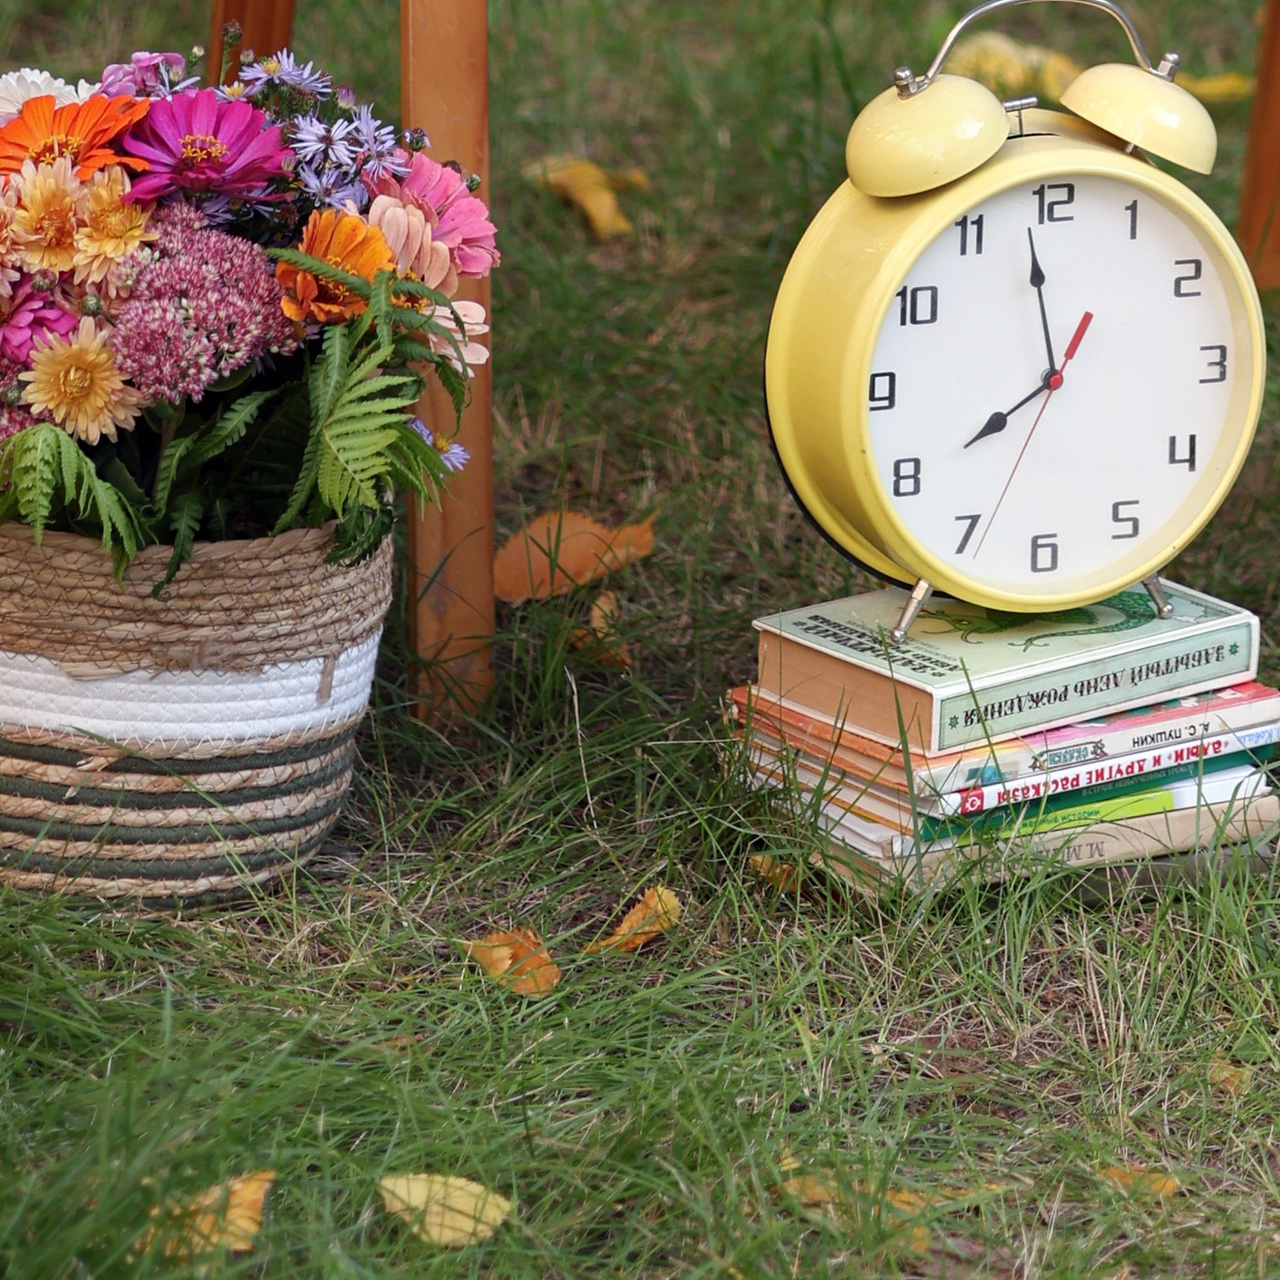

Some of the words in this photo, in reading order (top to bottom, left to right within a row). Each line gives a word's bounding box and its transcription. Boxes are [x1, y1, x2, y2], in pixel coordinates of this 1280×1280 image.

[1033, 183, 1075, 225] 12
[1125, 199, 1138, 240] 1
[955, 214, 984, 256] 11
[1173, 258, 1202, 298] 2
[895, 285, 938, 327] 10
[1199, 345, 1227, 384] 3
[868, 371, 896, 412] 9
[1168, 433, 1197, 472] 4
[893, 457, 921, 498] 8
[954, 513, 982, 555] 7
[1111, 500, 1140, 540] 5
[1030, 533, 1058, 573] 6
[1074, 669, 1126, 697] ДЕНЬ
[1131, 644, 1225, 685] ЗАБЫТЫЙ
[1132, 728, 1183, 748] ПУШКИН
